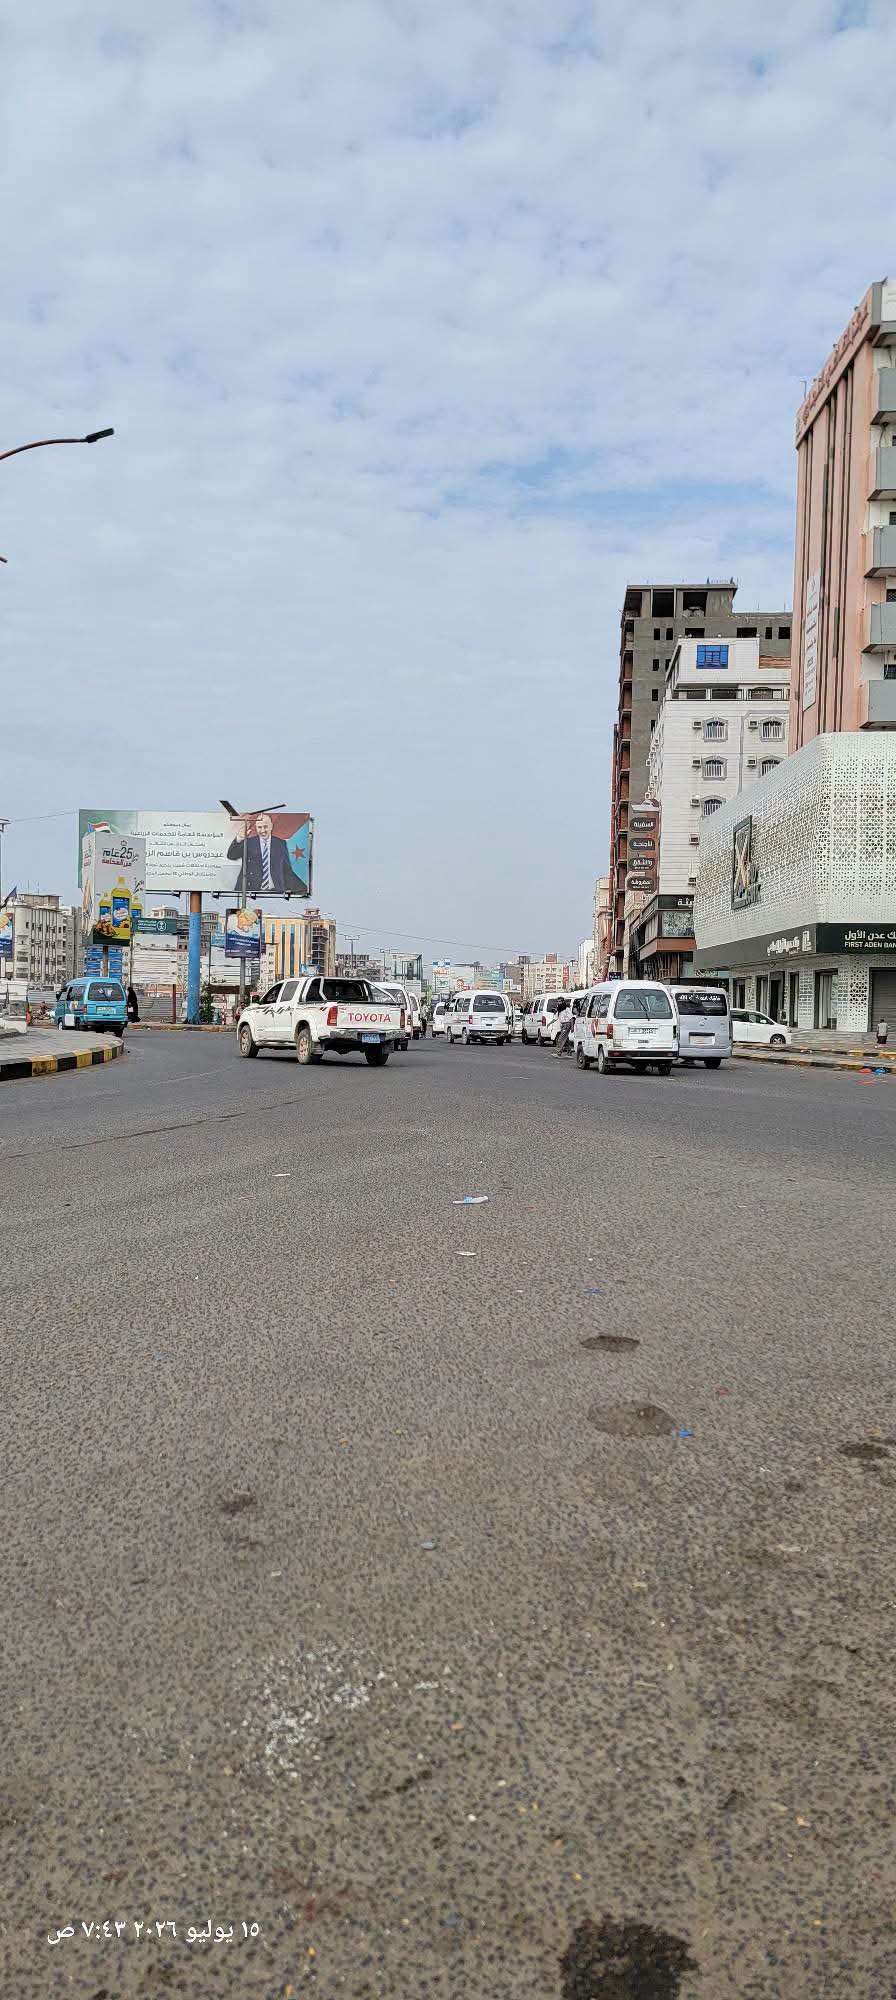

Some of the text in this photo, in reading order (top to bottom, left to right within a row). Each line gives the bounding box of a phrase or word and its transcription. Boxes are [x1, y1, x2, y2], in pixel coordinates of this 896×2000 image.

[120, 847, 133, 859] 25
[845, 930, 865, 941] الأول
[868, 932, 885, 940] عدن
[348, 1013, 392, 1022] TOYOTA
